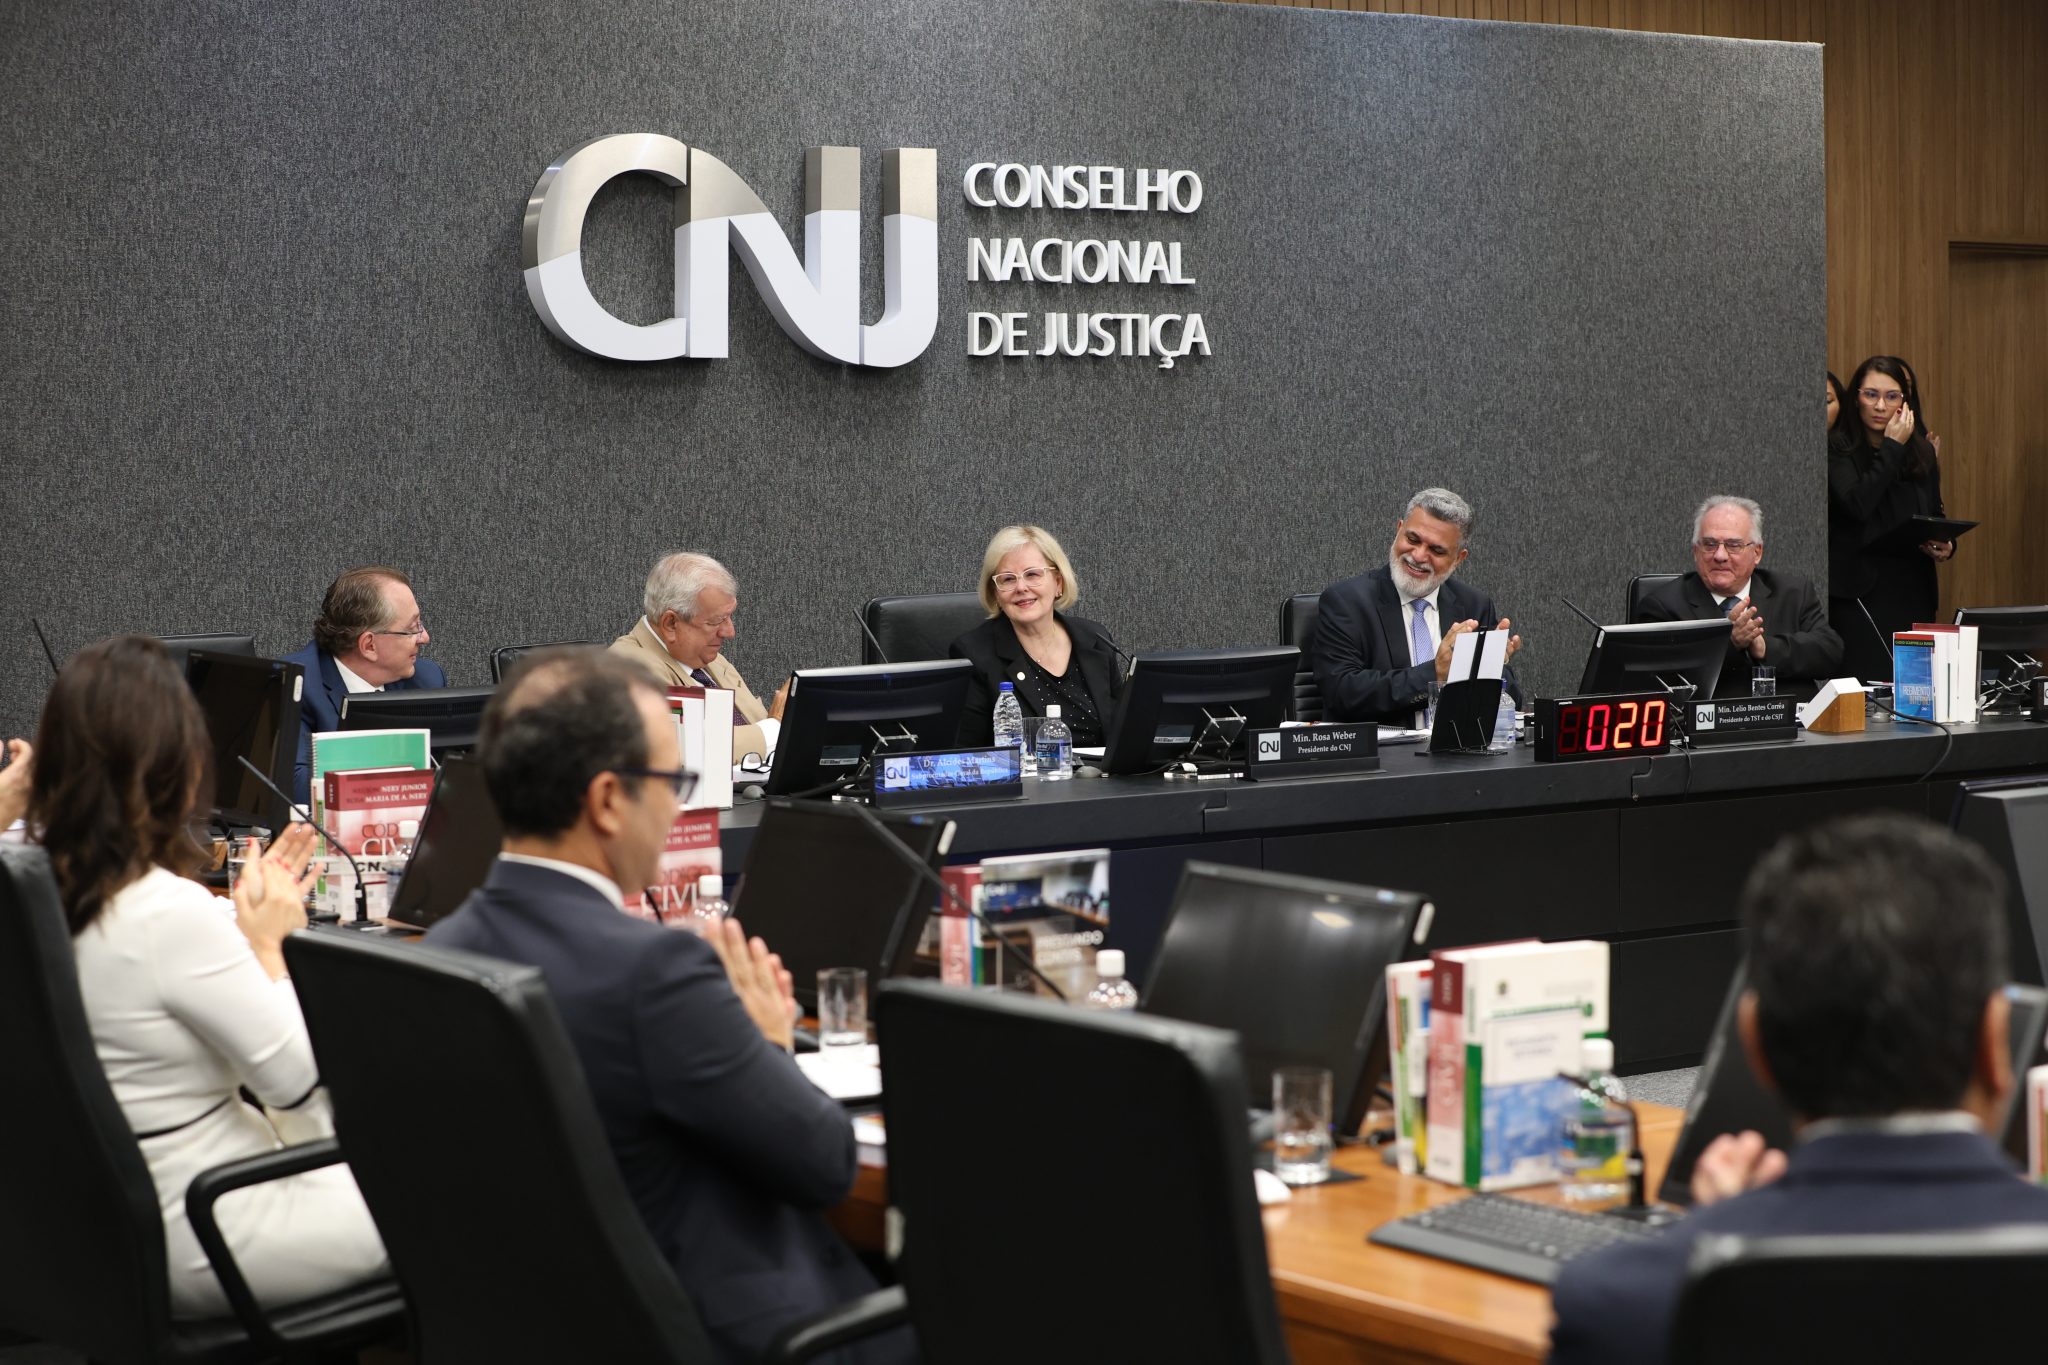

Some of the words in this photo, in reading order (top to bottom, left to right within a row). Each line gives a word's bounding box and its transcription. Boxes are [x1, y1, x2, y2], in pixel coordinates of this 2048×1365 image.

[963, 162, 1202, 214] CONSELHO
[522, 133, 938, 368] CNJ
[967, 237, 1195, 285] NACIONAL
[967, 311, 1029, 357] DE
[1035, 313, 1212, 369] JUSTIÇA
[1697, 711, 1714, 723] CNJ
[1292, 734, 1311, 743] Min.
[1312, 733, 1331, 741] Rosa
[1332, 731, 1356, 740] Weber
[1259, 741, 1279, 754] CNJ
[1298, 746, 1329, 754] Presidente
[1338, 744, 1352, 752] CNJ
[923, 758, 935, 768] Dr.
[885, 765, 908, 780] CNJ
[400, 783, 427, 792] JUNIOR
[366, 794, 390, 803] MARIA
[391, 793, 400, 801] DE
[409, 792, 428, 800] NERY
[640, 882, 697, 913] CIVI
